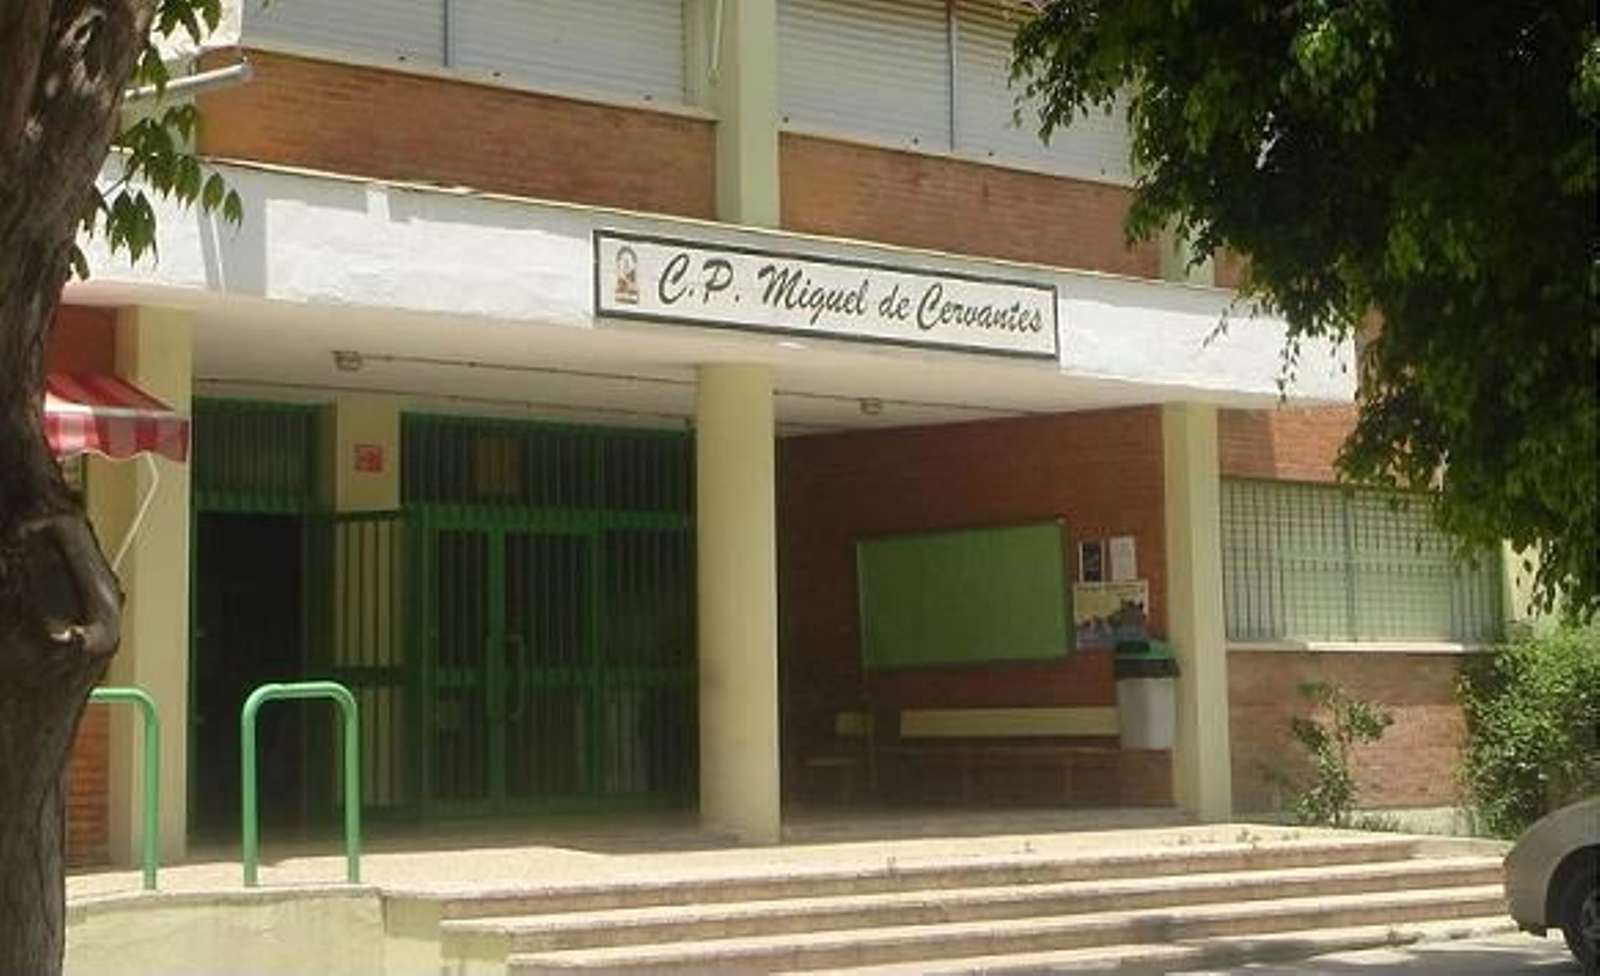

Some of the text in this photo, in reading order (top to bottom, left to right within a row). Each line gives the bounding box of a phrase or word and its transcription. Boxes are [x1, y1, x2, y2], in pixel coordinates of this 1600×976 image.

[758, 265, 868, 325] Miguel
[879, 285, 910, 320] de
[917, 282, 1043, 333] Cervantes
